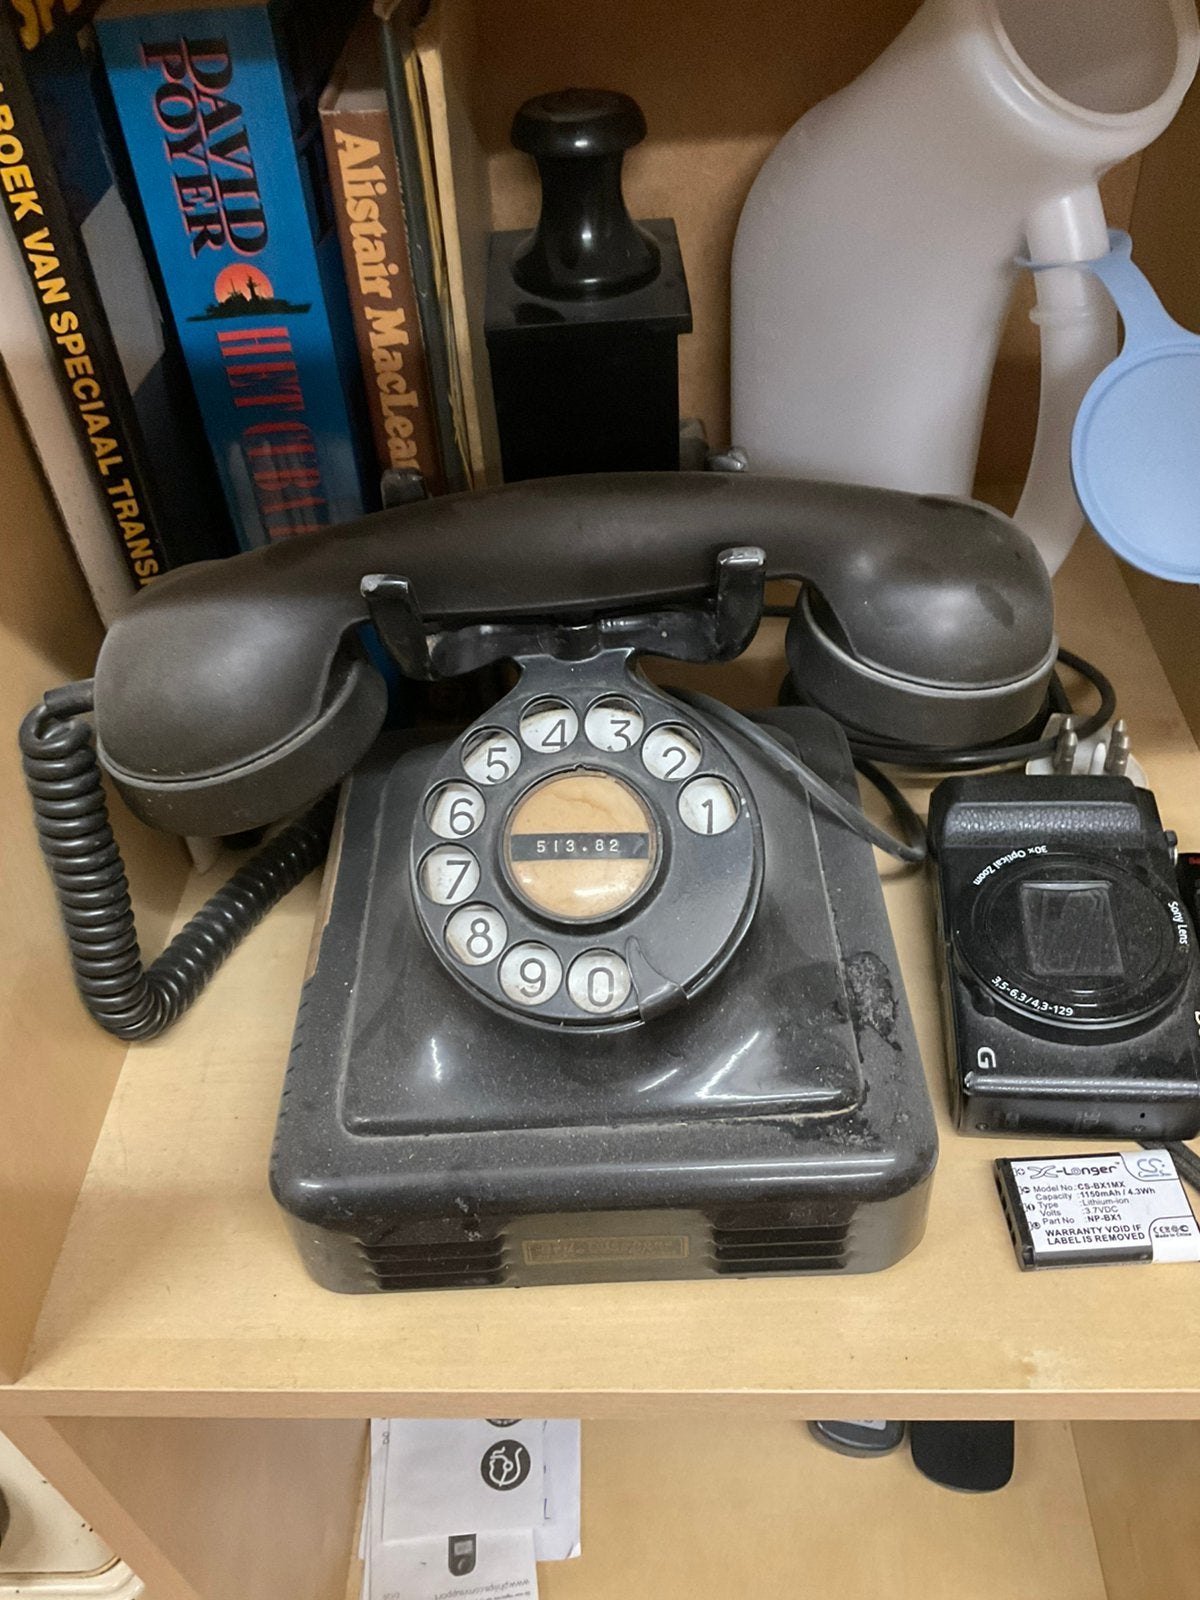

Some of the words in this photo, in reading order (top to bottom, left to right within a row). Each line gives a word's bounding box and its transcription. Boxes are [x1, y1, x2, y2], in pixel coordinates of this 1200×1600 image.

[139, 37, 227, 259] POYER
[181, 36, 269, 257] DAVID
[335, 129, 399, 299] Alistair
[23, 226, 71, 305] VAN
[50, 311, 124, 476] SPECIAAL
[541, 718, 567, 750] 4
[608, 719, 632, 751] 3
[486, 746, 510, 782] 5
[662, 746, 687, 779] 2
[449, 798, 475, 835] 6
[701, 799, 714, 834] 1
[536, 838, 620, 853] 513.82
[993, 850, 1026, 869] Optical
[1027, 845, 1048, 854] 30x
[446, 860, 471, 900] 7
[973, 865, 996, 885] Zoom
[466, 917, 493, 957] 8
[1167, 901, 1184, 922] Sony
[1177, 924, 1188, 944] Lens
[519, 958, 546, 998] 9
[587, 966, 614, 1006] 0
[977, 1046, 996, 1069] G
[1033, 1184, 1059, 1192] Model
[1035, 1192, 1072, 1201] Capacity
[1128, 1187, 1156, 1195] 4.3Wh
[1037, 1201, 1059, 1209] Type
[1040, 1209, 1061, 1217] Volts
[1042, 1217, 1061, 1225] Part
[1045, 1226, 1103, 1237] WARRANTY
[1105, 1225, 1130, 1234] VOID
[1132, 1224, 1142, 1232] IF
[1047, 1236, 1081, 1246] LABEL
[1095, 1232, 1145, 1242] REMOVED
